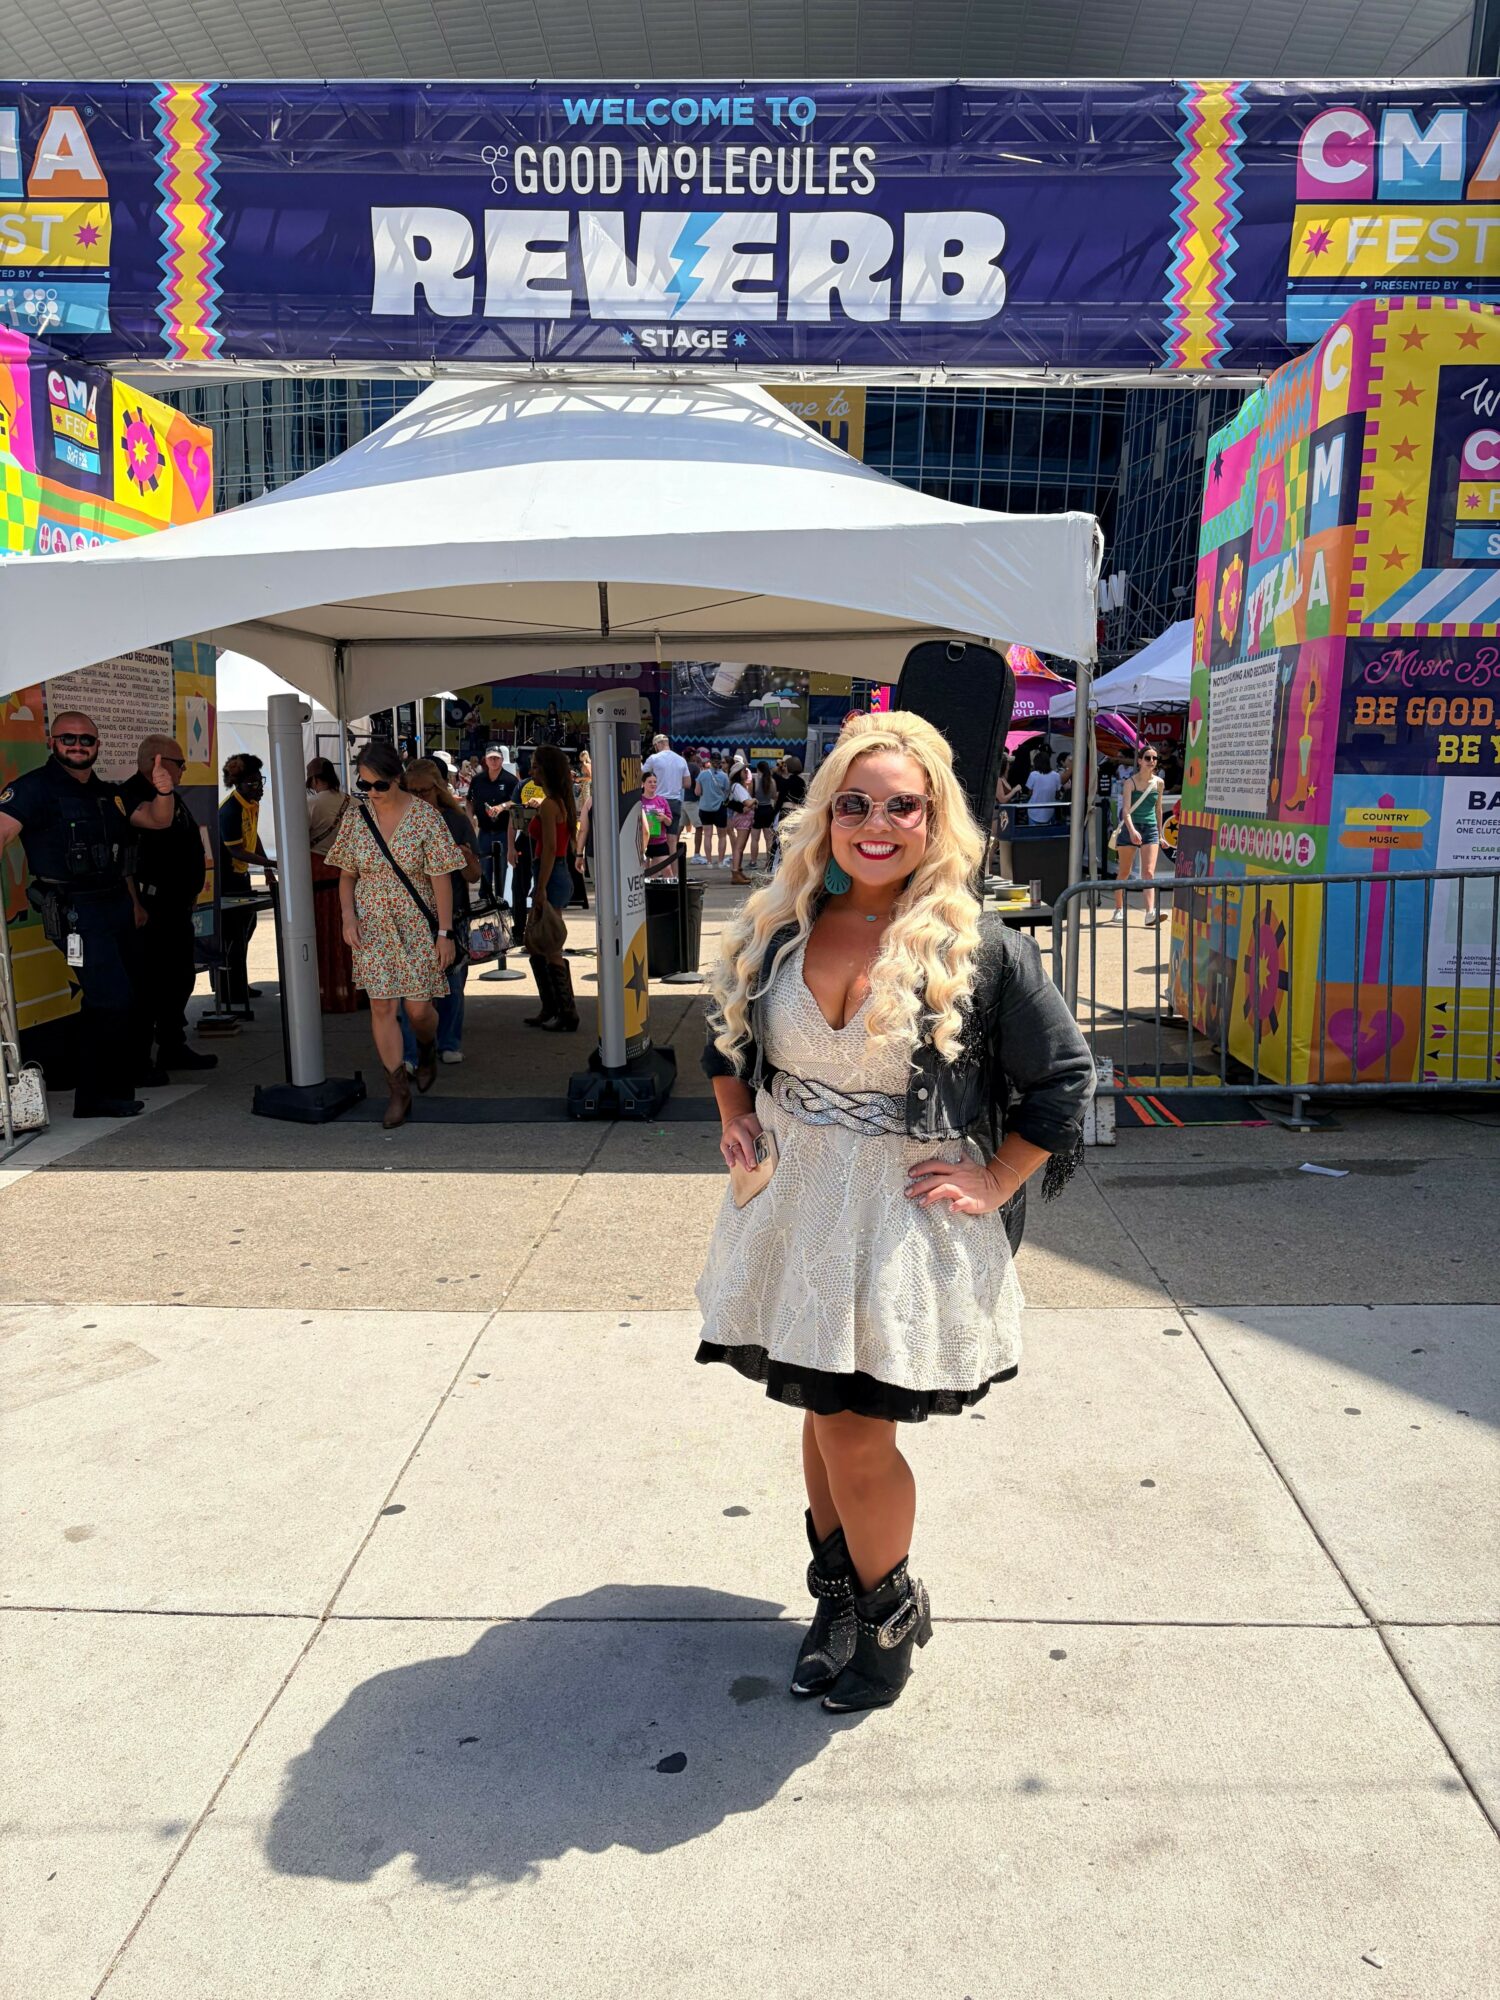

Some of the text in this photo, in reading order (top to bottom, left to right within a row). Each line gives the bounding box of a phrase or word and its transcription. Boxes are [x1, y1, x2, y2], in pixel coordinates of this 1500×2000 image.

[562, 96, 817, 127] WELCOME TO
[514, 144, 877, 196] GOOD MOLECULES
[18, 270, 32, 278] BY
[371, 206, 1007, 322] REVERB
[1374, 281, 1459, 291] PRESENTED BY
[641, 328, 728, 350] STAGE
[48, 370, 98, 415] CMA
[825, 389, 850, 417] to
[65, 414, 88, 440] FEST
[134, 652, 169, 666] RECORDING
[1354, 697, 1398, 725] BE
[1143, 721, 1173, 736] AID
[1437, 735, 1482, 763] BE
[1362, 813, 1409, 821] COUNTRY
[1369, 836, 1399, 844] MUSIC
